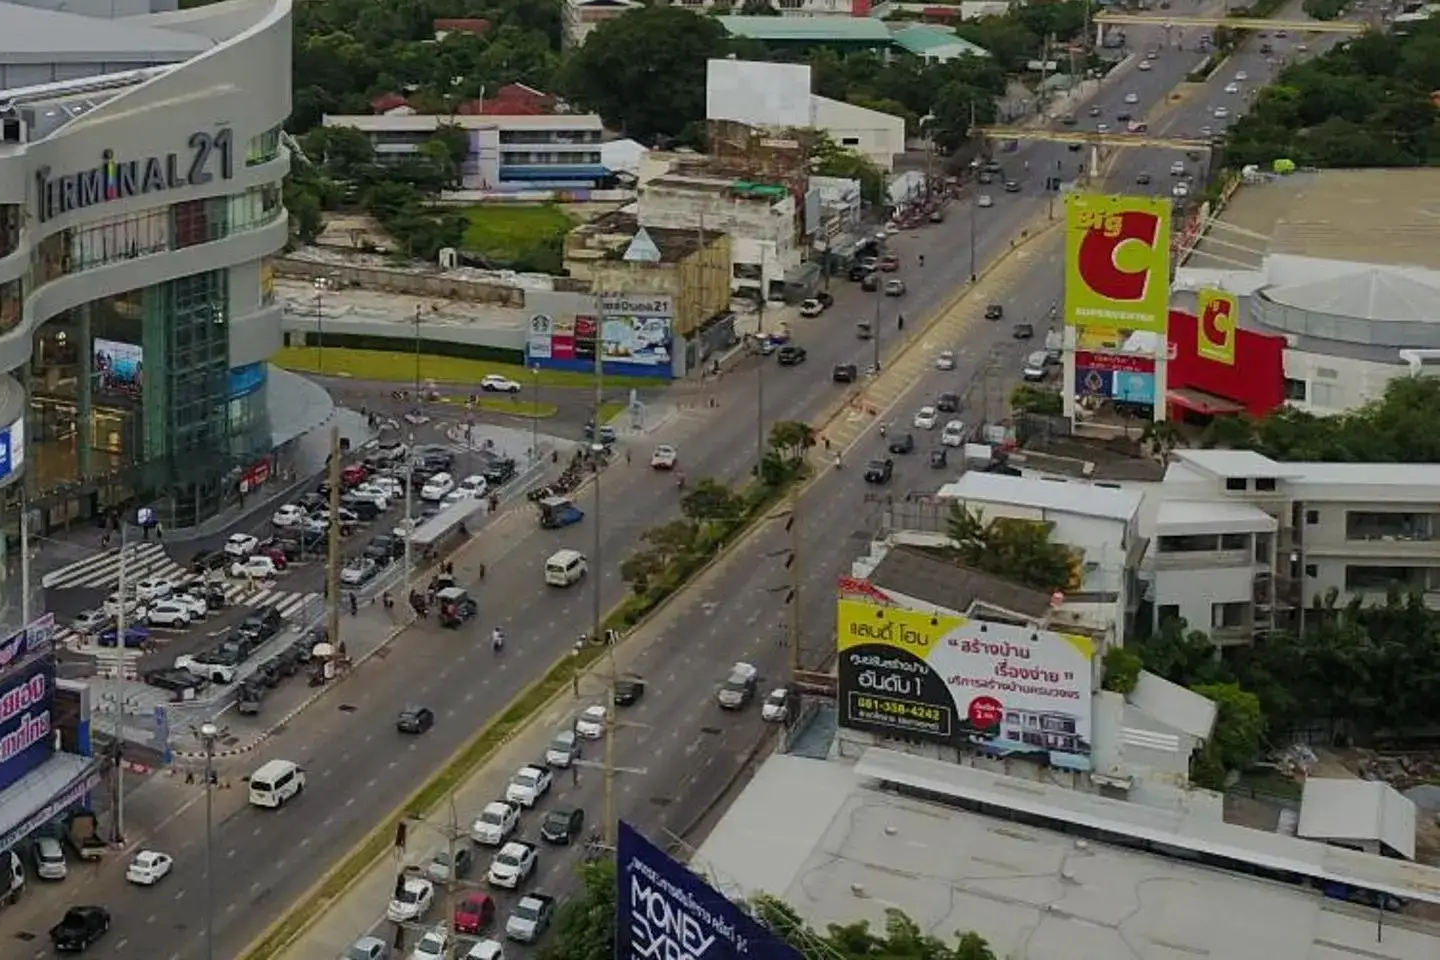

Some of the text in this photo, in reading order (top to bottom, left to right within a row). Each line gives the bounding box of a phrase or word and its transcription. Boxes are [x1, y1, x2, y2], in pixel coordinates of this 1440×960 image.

[1076, 210, 1123, 238] Big
[1077, 209, 1161, 303] C
[961, 638, 1030, 659] สร้างบ้าน
[858, 669, 911, 694] อันดับ
[994, 659, 1059, 682] เรื่องง่าย
[632, 874, 716, 957] MONEY
[632, 910, 696, 960] EXP
